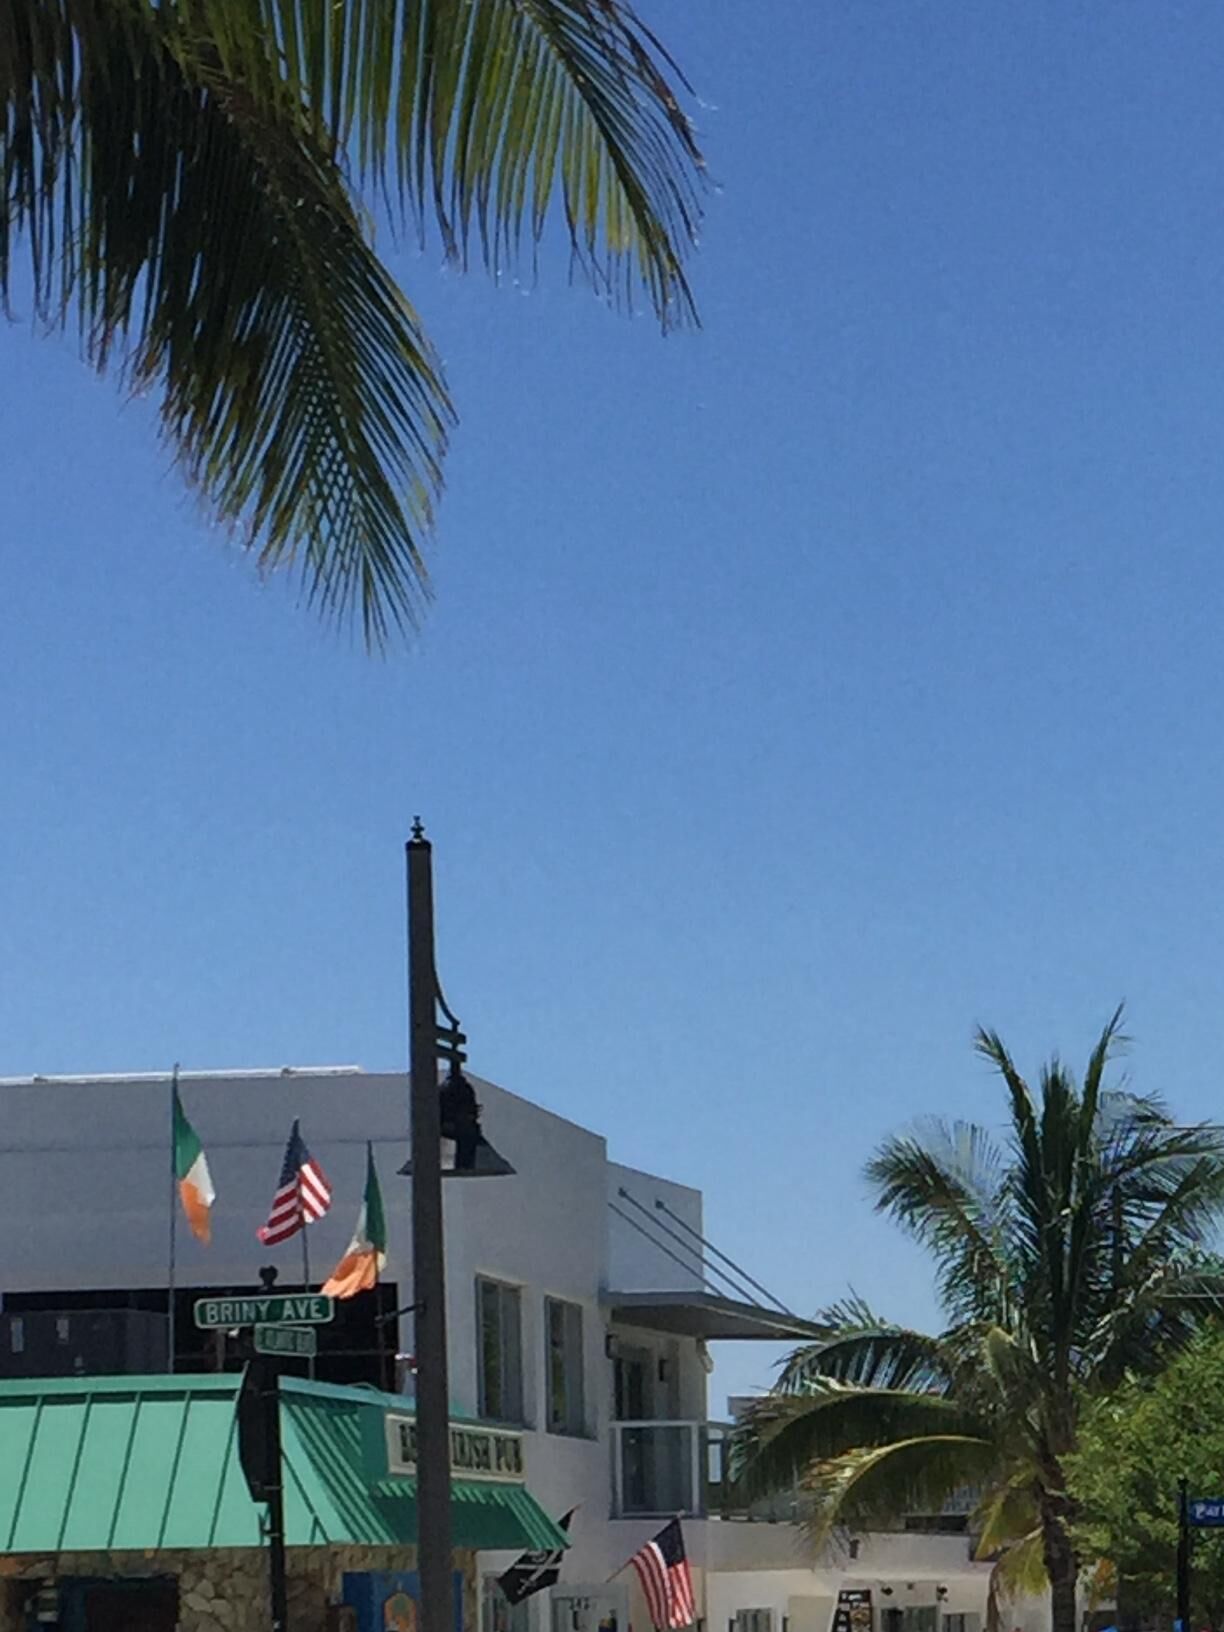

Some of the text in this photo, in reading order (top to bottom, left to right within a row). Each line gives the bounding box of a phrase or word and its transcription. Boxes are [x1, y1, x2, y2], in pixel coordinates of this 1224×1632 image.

[206, 1298, 324, 1324] BRINY AVE
[451, 1430, 491, 1470] IRISH
[496, 1436, 522, 1473] PUB
